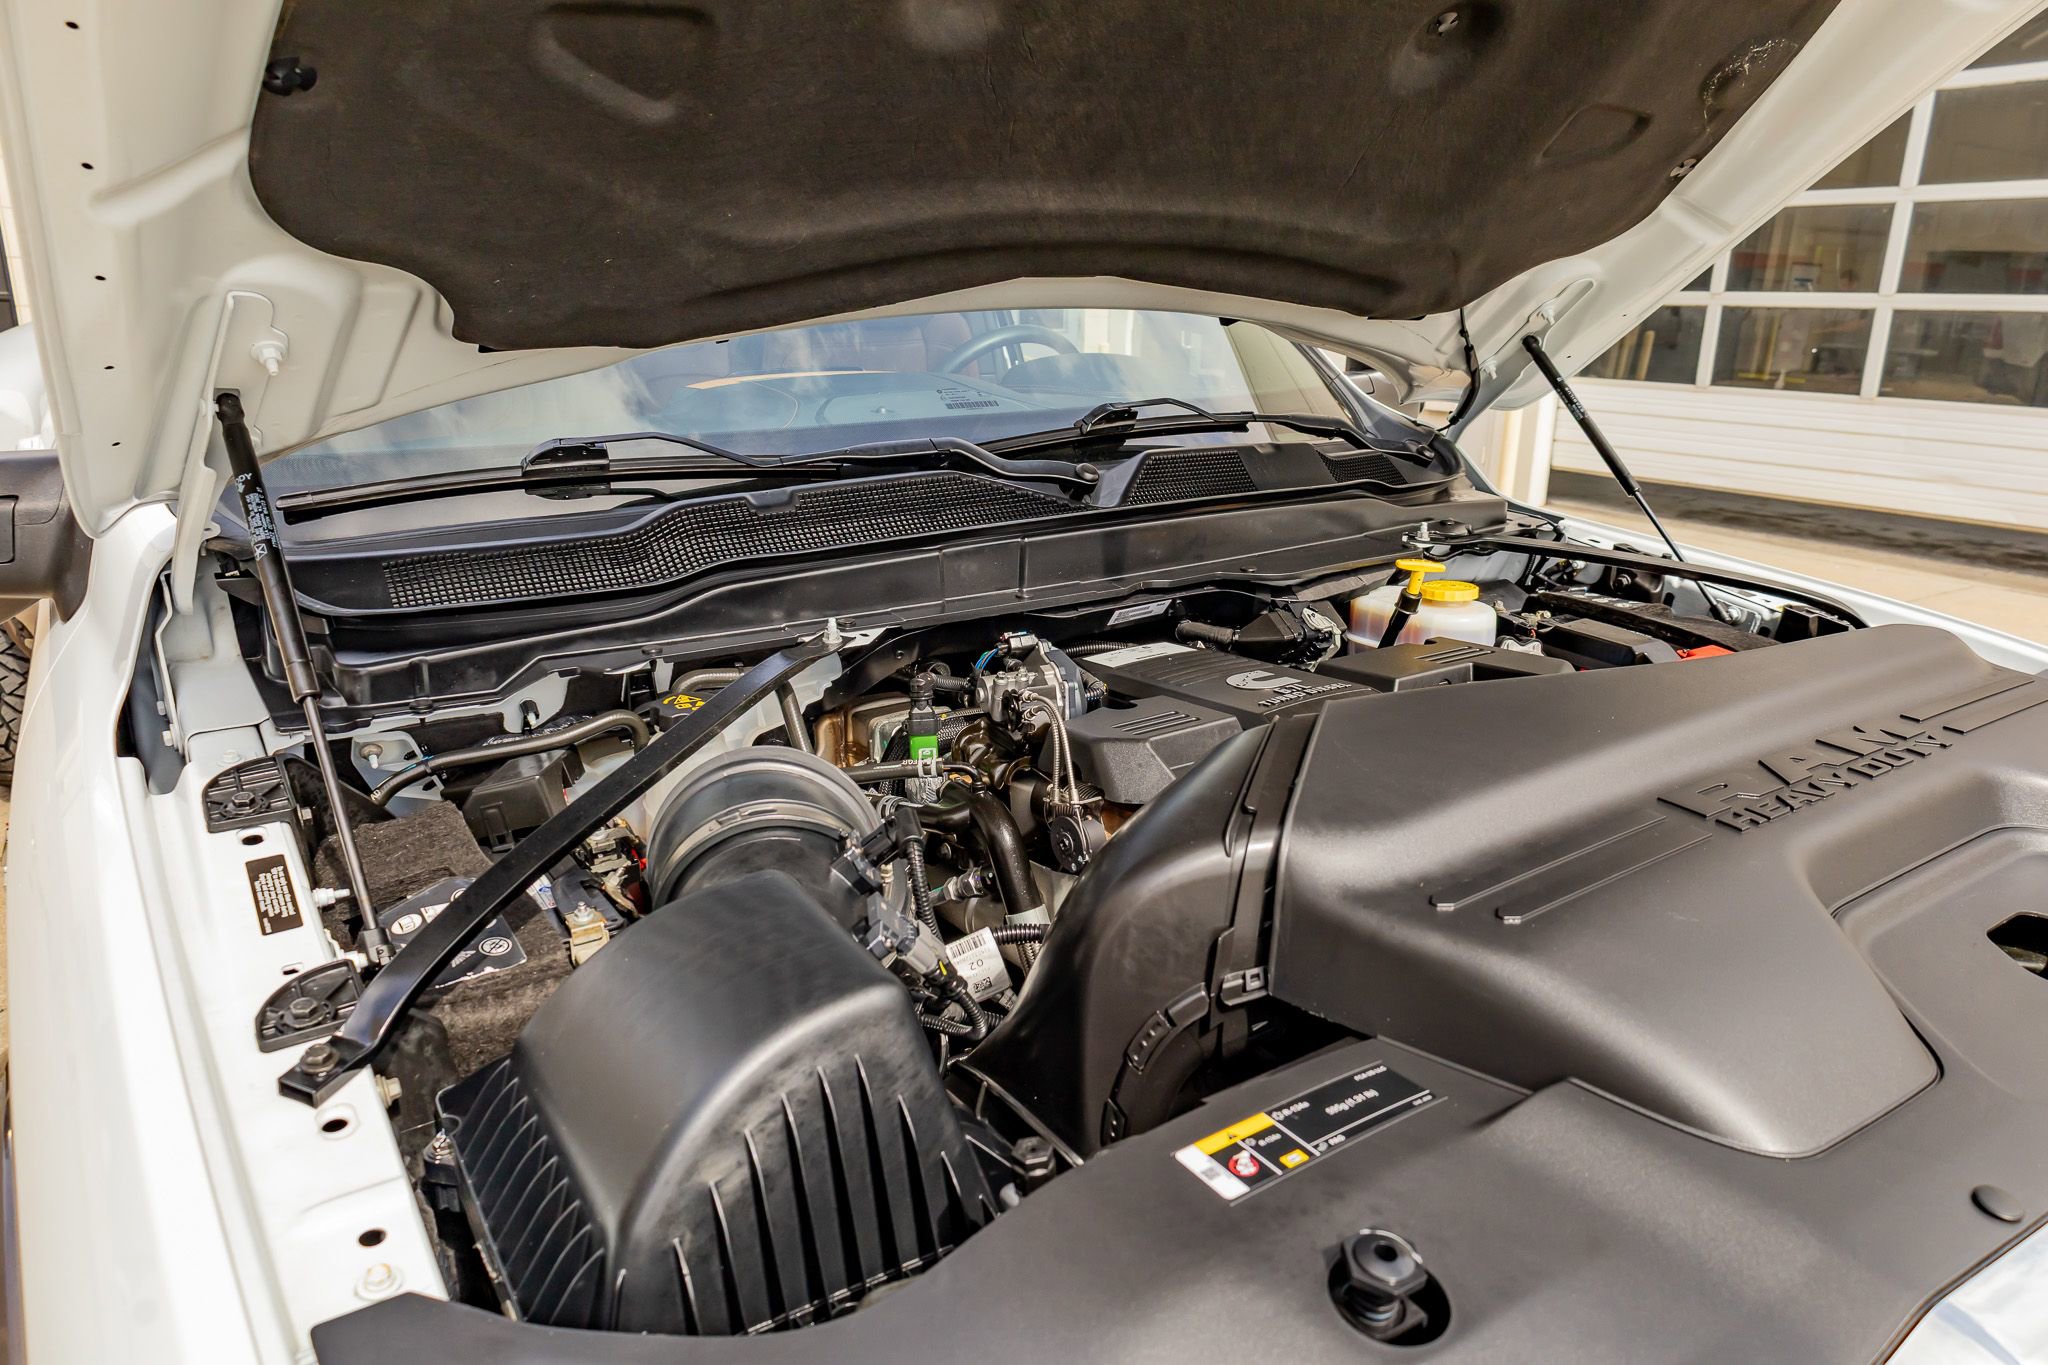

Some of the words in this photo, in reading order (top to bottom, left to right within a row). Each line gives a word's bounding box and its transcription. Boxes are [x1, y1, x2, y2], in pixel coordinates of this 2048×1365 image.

[1656, 724, 1926, 820] RAM
[1715, 773, 1859, 833] HEAVY
[1847, 735, 1953, 779] DUTY
